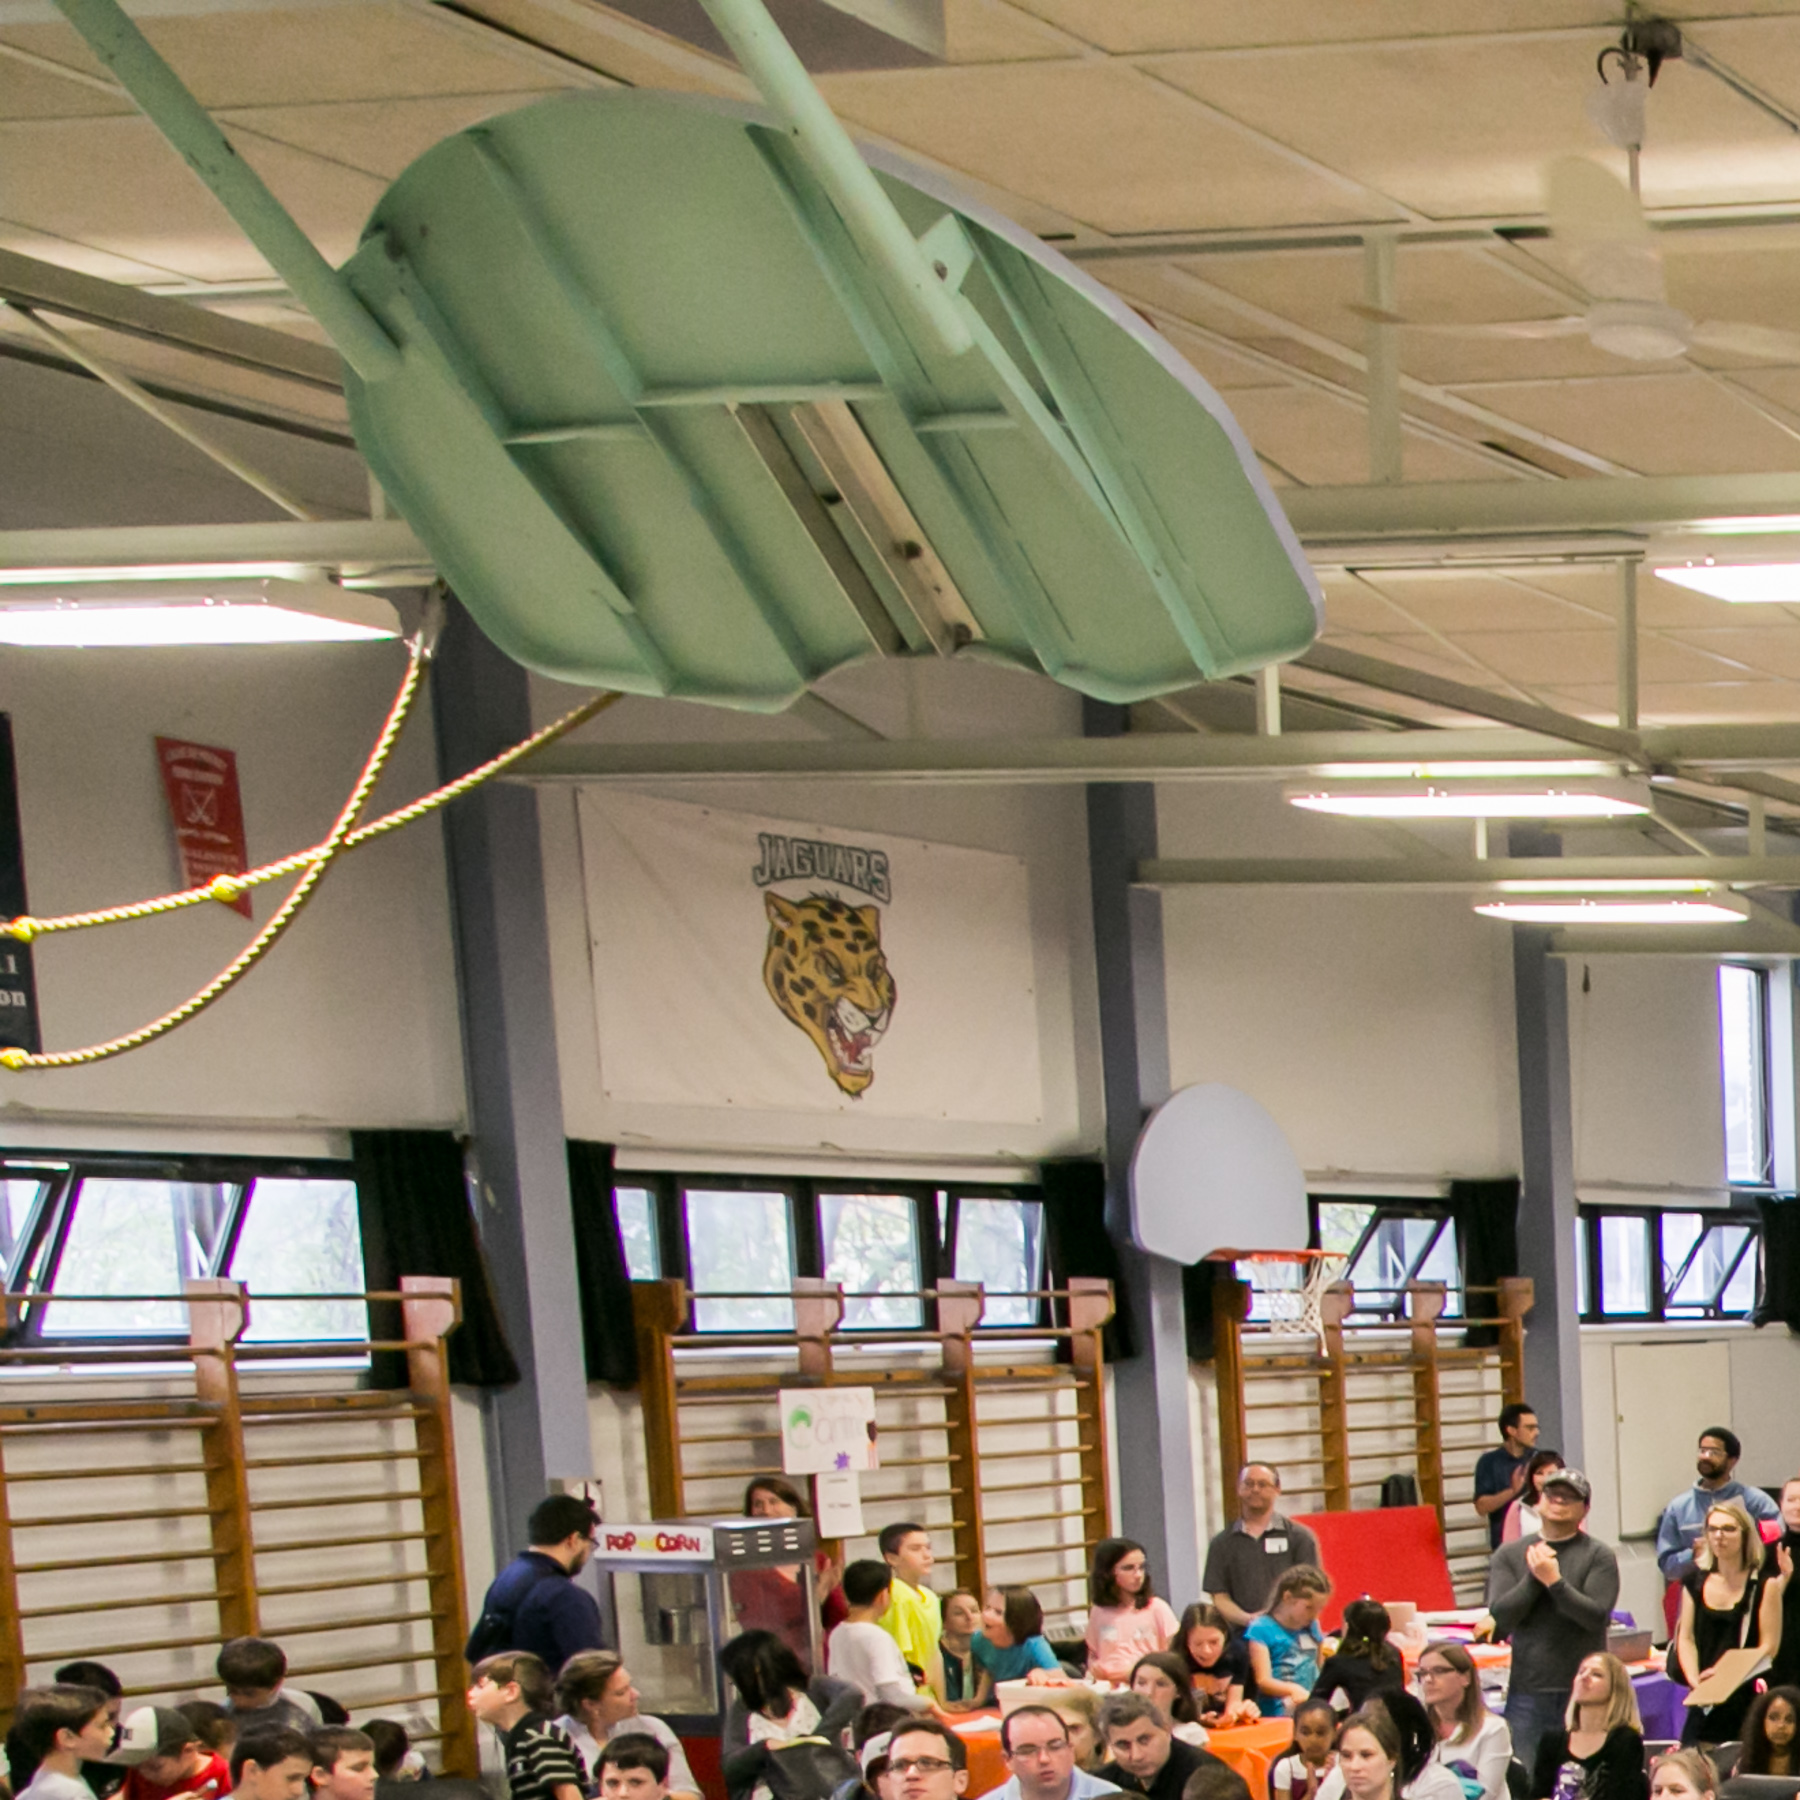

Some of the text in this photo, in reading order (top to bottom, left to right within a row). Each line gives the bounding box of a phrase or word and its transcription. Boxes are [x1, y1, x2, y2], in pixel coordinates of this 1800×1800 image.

[752, 832, 891, 905] JAGUARS
[605, 1531, 701, 1553] POP CORN
